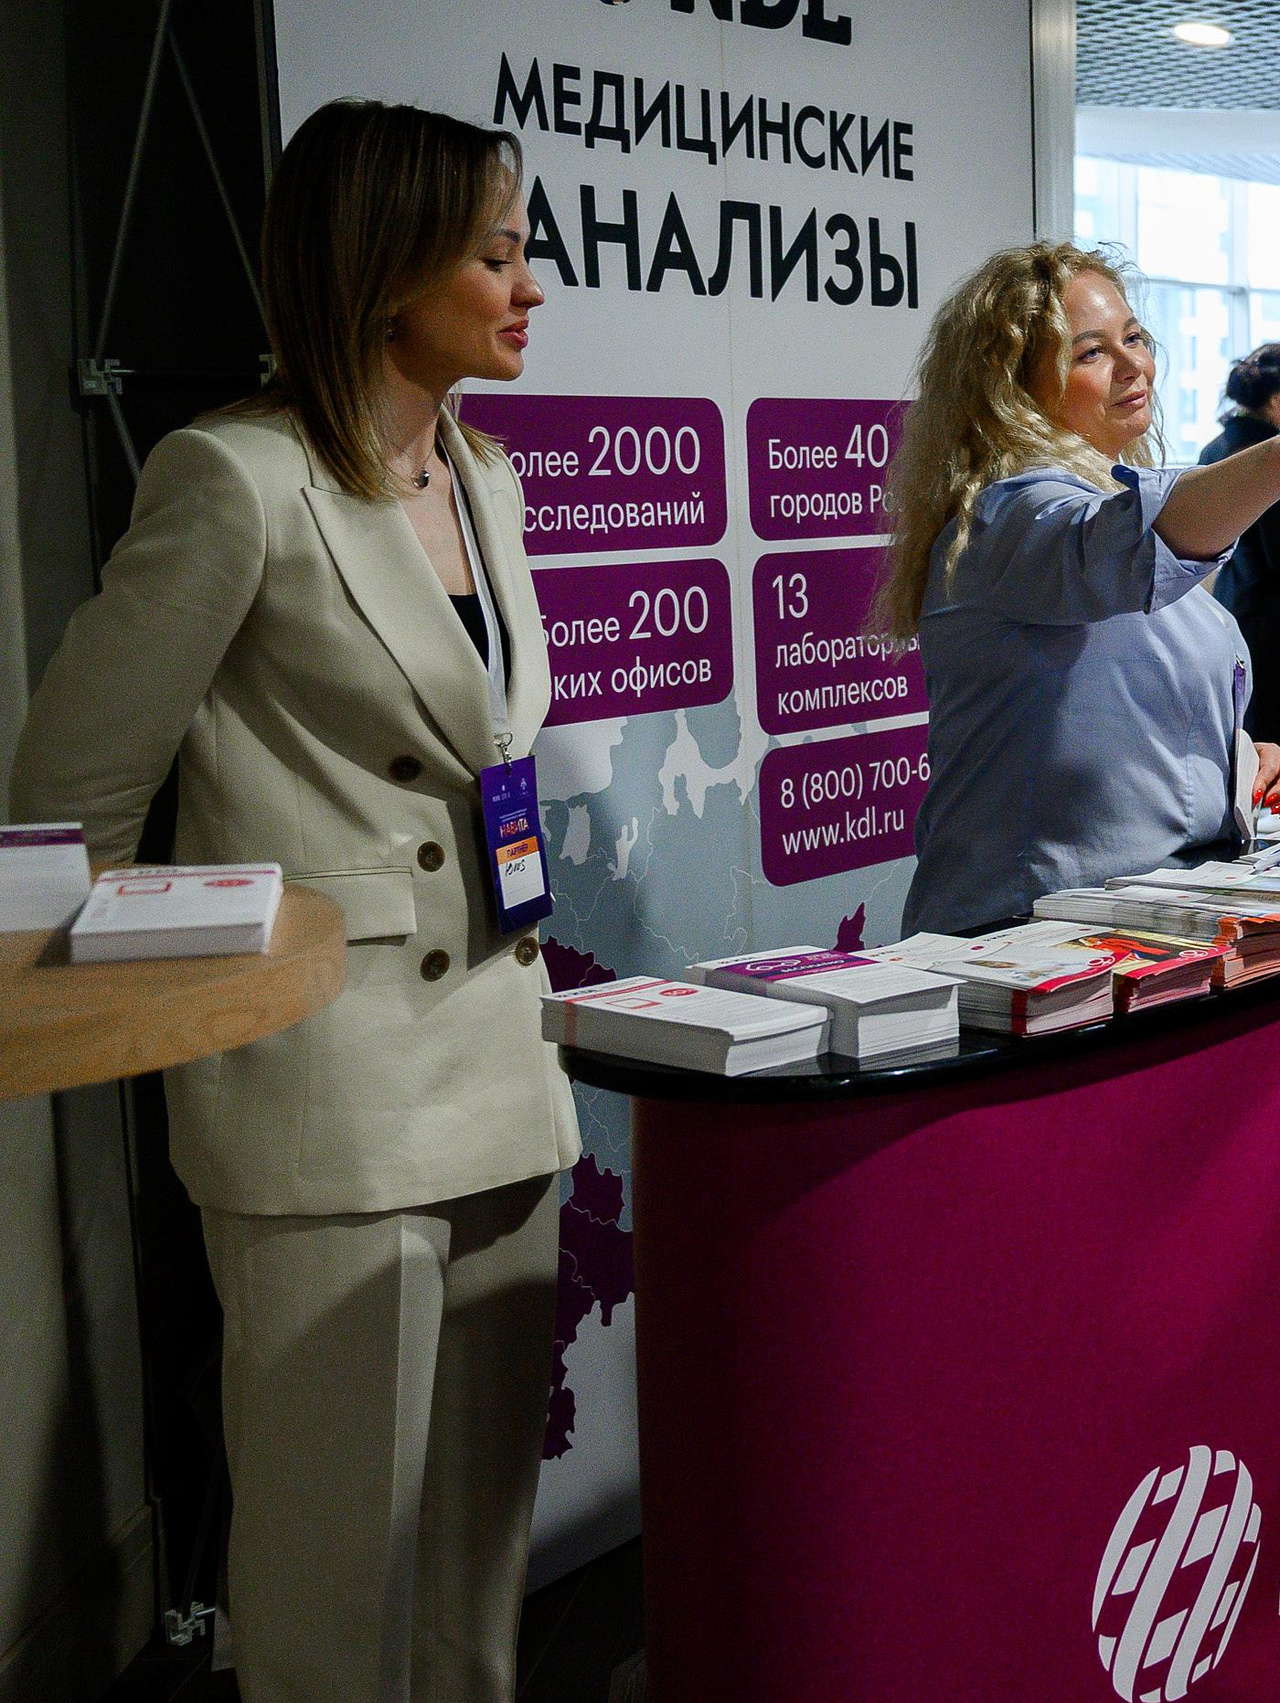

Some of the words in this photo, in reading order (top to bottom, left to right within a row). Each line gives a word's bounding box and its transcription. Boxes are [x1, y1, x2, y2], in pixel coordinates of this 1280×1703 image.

[493, 51, 914, 182] МЕДИЦИНСКИЕ
[523, 175, 919, 309] АНАЛИЗЫ
[502, 444, 579, 478] олее
[588, 426, 701, 476] 2000
[768, 438, 838, 470] Более
[844, 424, 889, 468] 40
[523, 490, 705, 534] сследований
[770, 492, 863, 524] городов
[628, 585, 709, 638] 200
[772, 573, 809, 620] 13
[551, 671, 603, 700] ких
[611, 656, 712, 698] офисов
[778, 675, 909, 715] комплексов
[780, 778, 795, 809] 8
[802, 763, 864, 810] (800)
[869, 752, 931, 791] 700-6
[782, 805, 905, 856] www.kdl.ru
